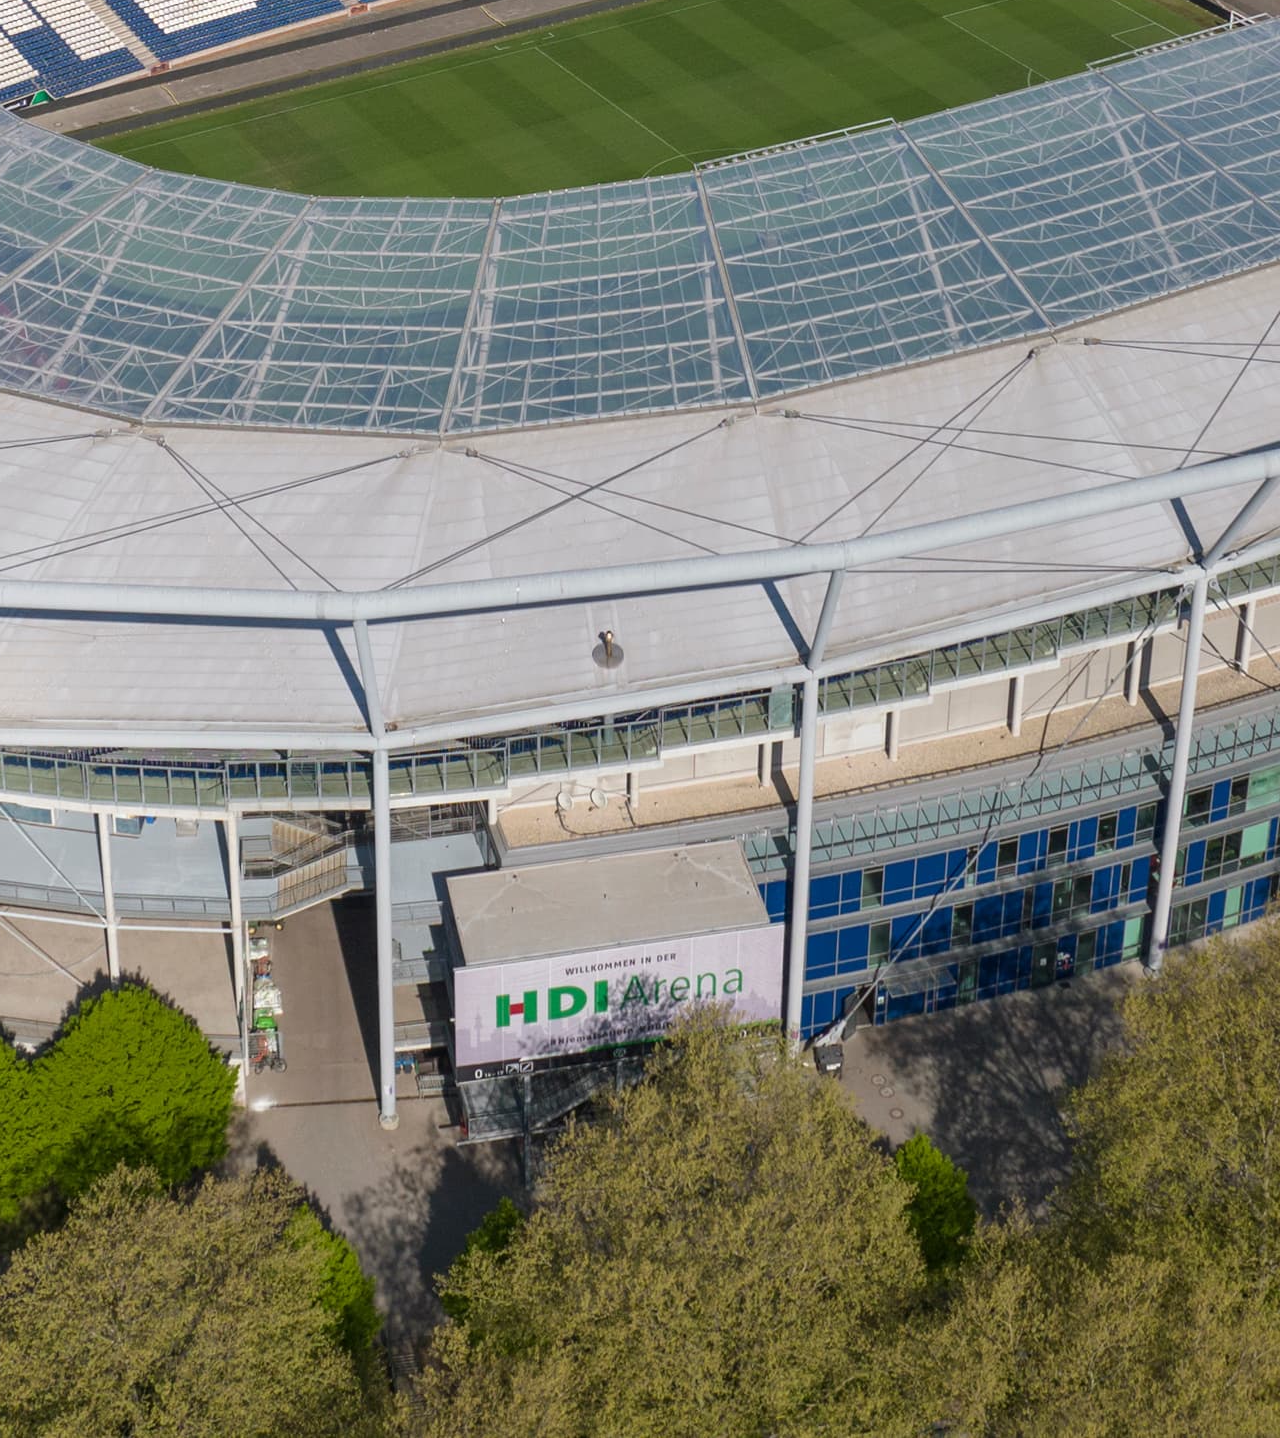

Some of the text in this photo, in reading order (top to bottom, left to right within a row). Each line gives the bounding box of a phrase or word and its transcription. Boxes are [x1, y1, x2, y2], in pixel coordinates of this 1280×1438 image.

[565, 952, 677, 976] WILLKOMMEN IN DER
[496, 967, 743, 1028] HDI Arena
